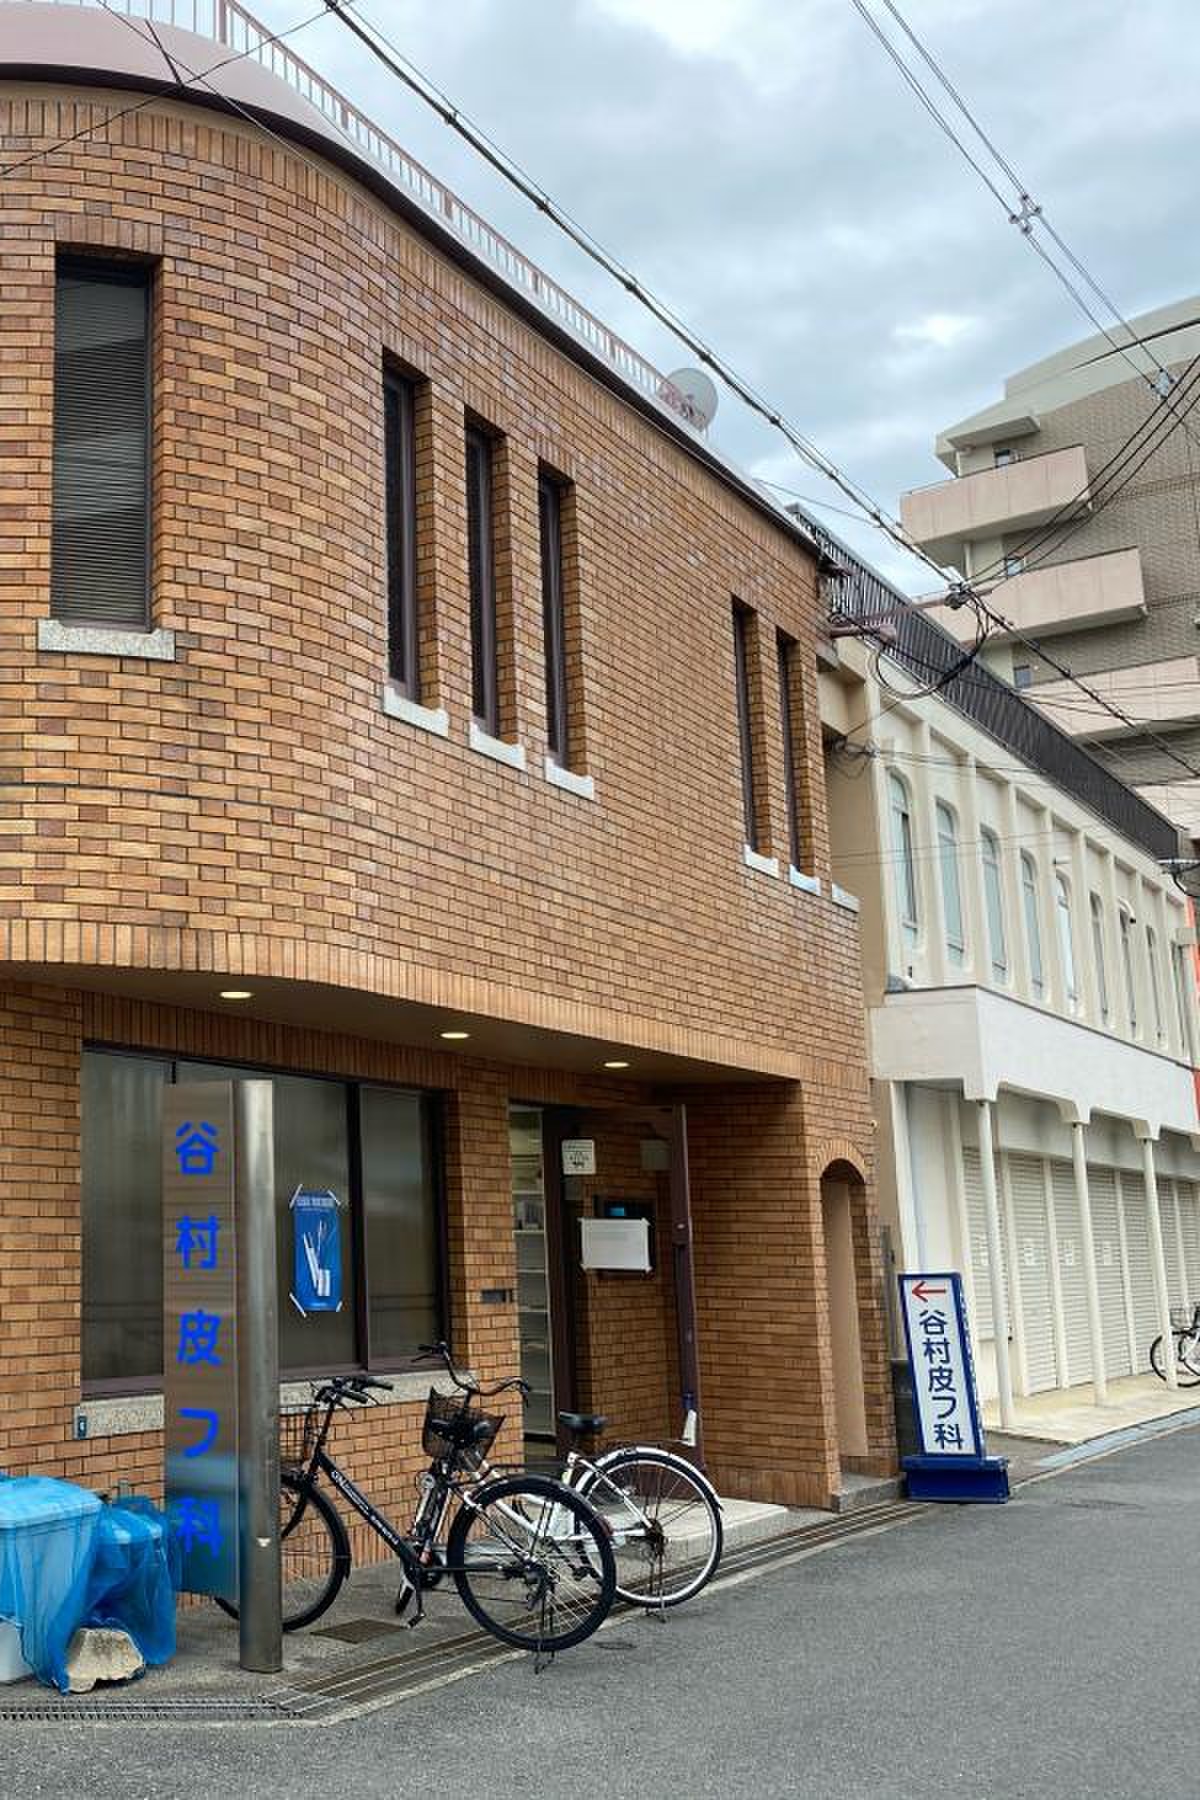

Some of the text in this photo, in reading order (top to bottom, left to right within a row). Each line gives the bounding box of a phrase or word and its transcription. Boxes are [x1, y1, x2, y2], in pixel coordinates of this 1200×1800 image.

[175, 1122, 222, 1557] 谷村皮フ科
[919, 1309, 963, 1450] 谷村皮フ科
